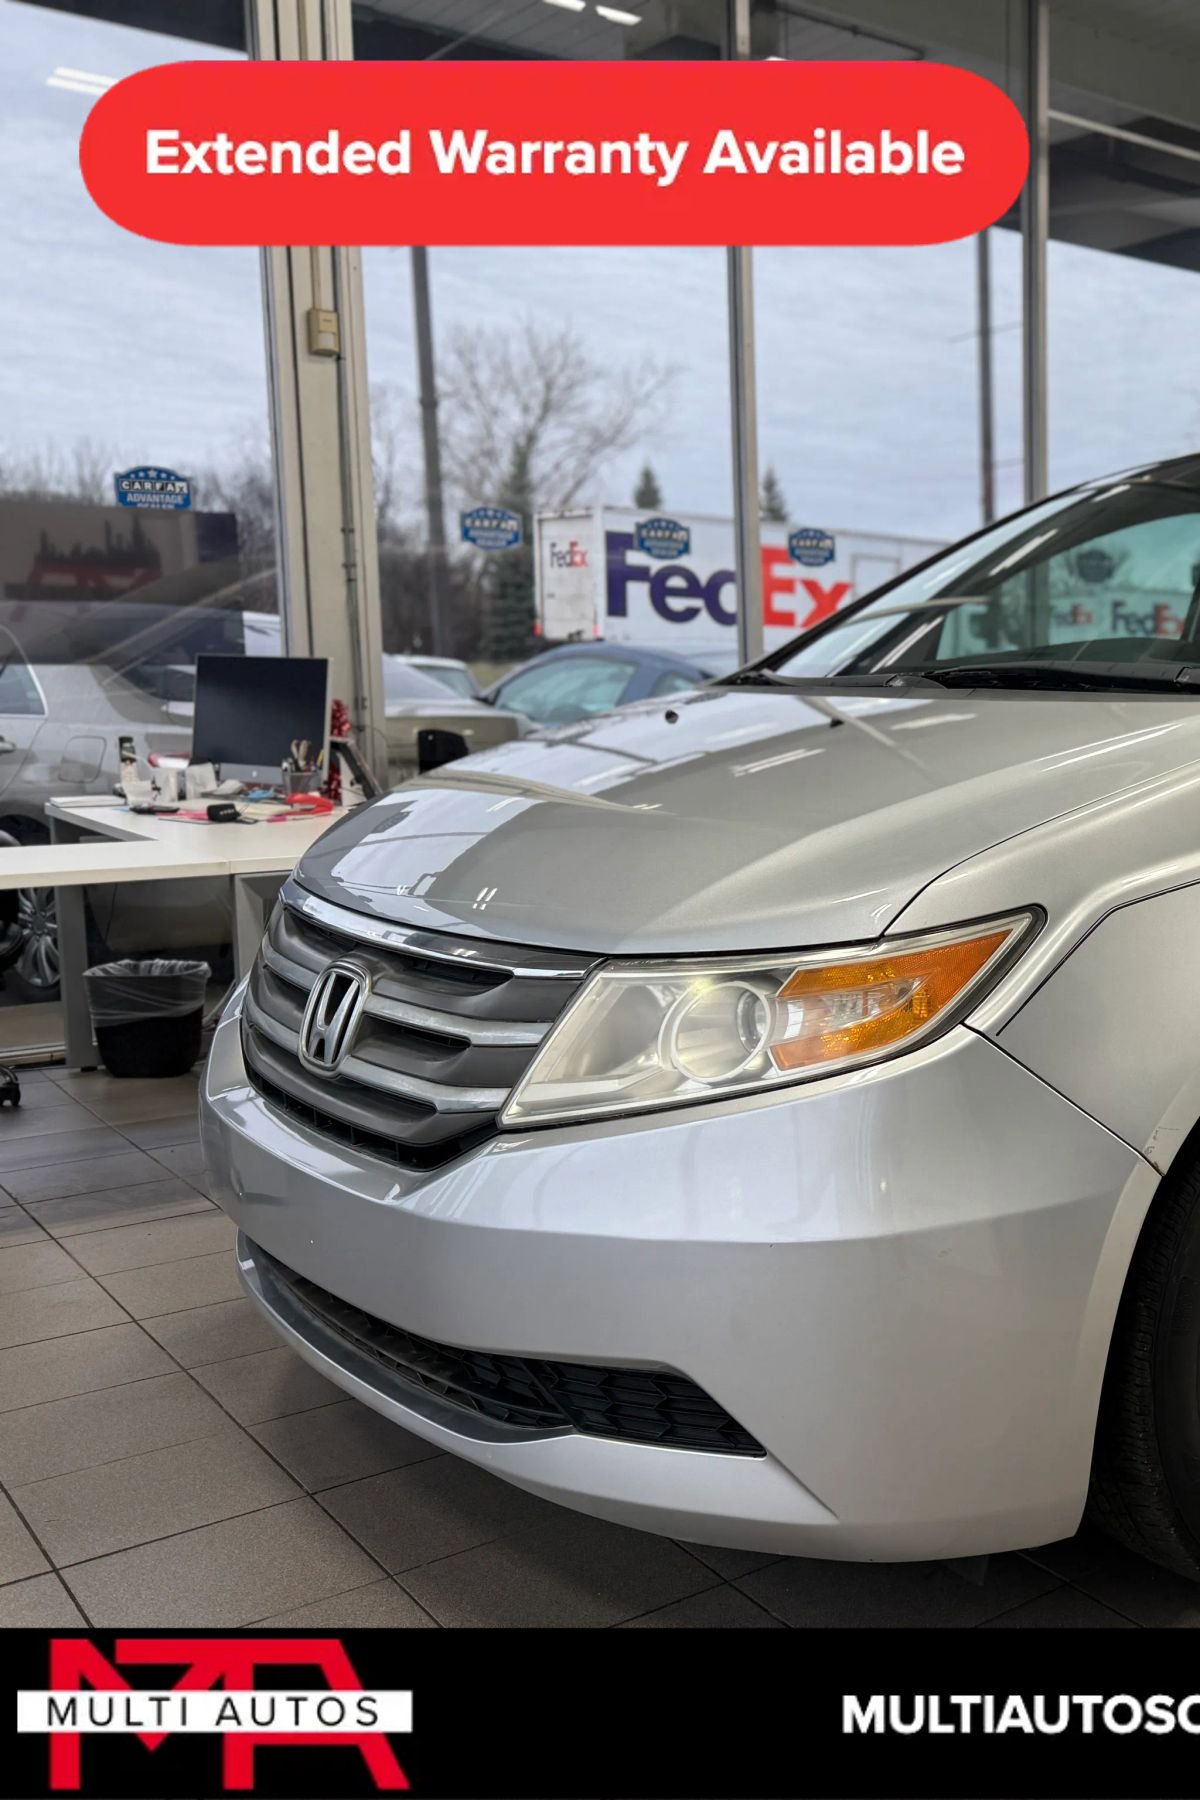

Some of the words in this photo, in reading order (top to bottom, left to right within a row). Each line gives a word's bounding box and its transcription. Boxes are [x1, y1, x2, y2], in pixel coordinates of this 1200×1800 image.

[121, 480, 188, 493] CARFAX
[126, 492, 184, 504] ADVANTAGE
[549, 540, 589, 569] FedEx
